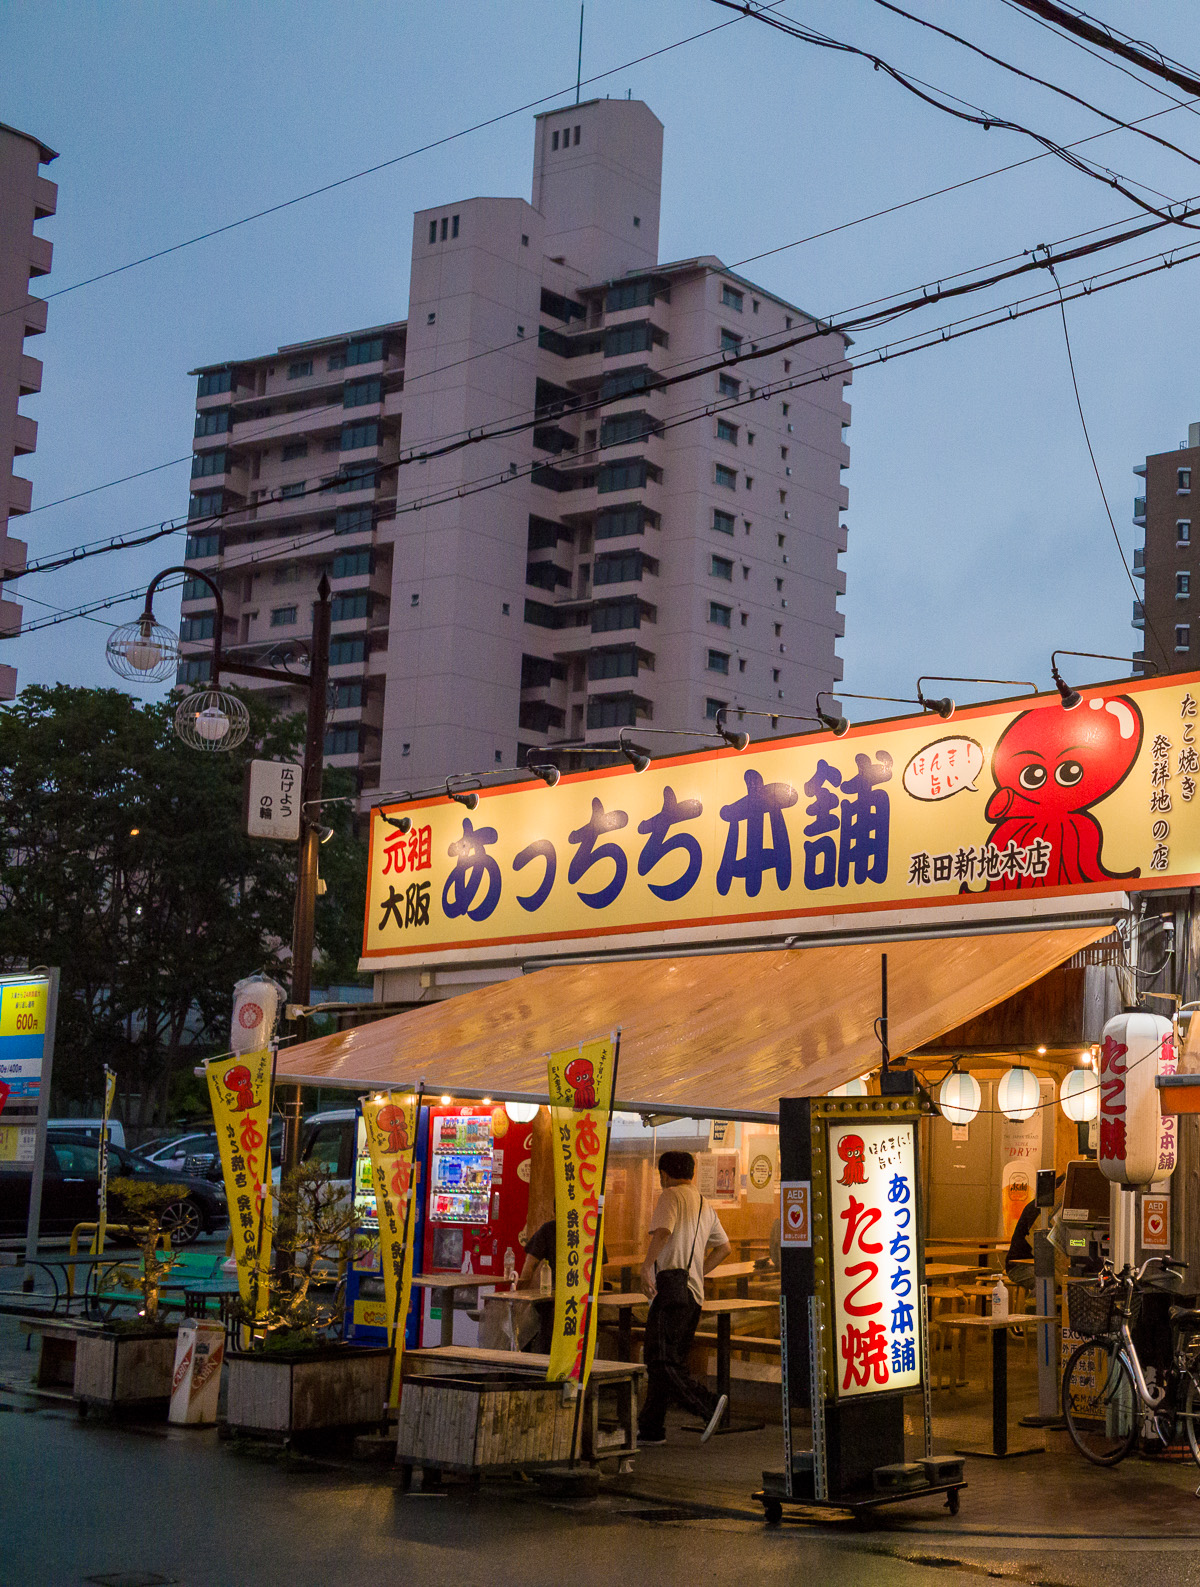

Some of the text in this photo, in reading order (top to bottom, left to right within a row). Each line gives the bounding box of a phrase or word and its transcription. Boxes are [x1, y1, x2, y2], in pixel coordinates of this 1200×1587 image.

[1179, 694, 1199, 800] たこ焼き
[259, 795, 273, 820] の輪
[280, 768, 294, 818] 広げよう
[931, 775, 959, 796] 旨い
[1151, 734, 1171, 870] 発祥地の店
[382, 825, 432, 875] 元祖
[442, 749, 893, 922] あっちち本舗
[908, 839, 1050, 885] 飛田新地本店
[378, 881, 431, 931] 大阪
[16, 1013, 38, 1031] 600円
[1158, 1063, 1177, 1170] あち本舗
[787, 1190, 804, 1200] AED
[1010, 1182, 1028, 1192] Asahi
[1148, 1202, 1164, 1211] AED
[840, 1195, 889, 1390] たこ焼
[888, 1173, 916, 1374] あっちち本舗
[191, 1357, 218, 1389] CABIN
